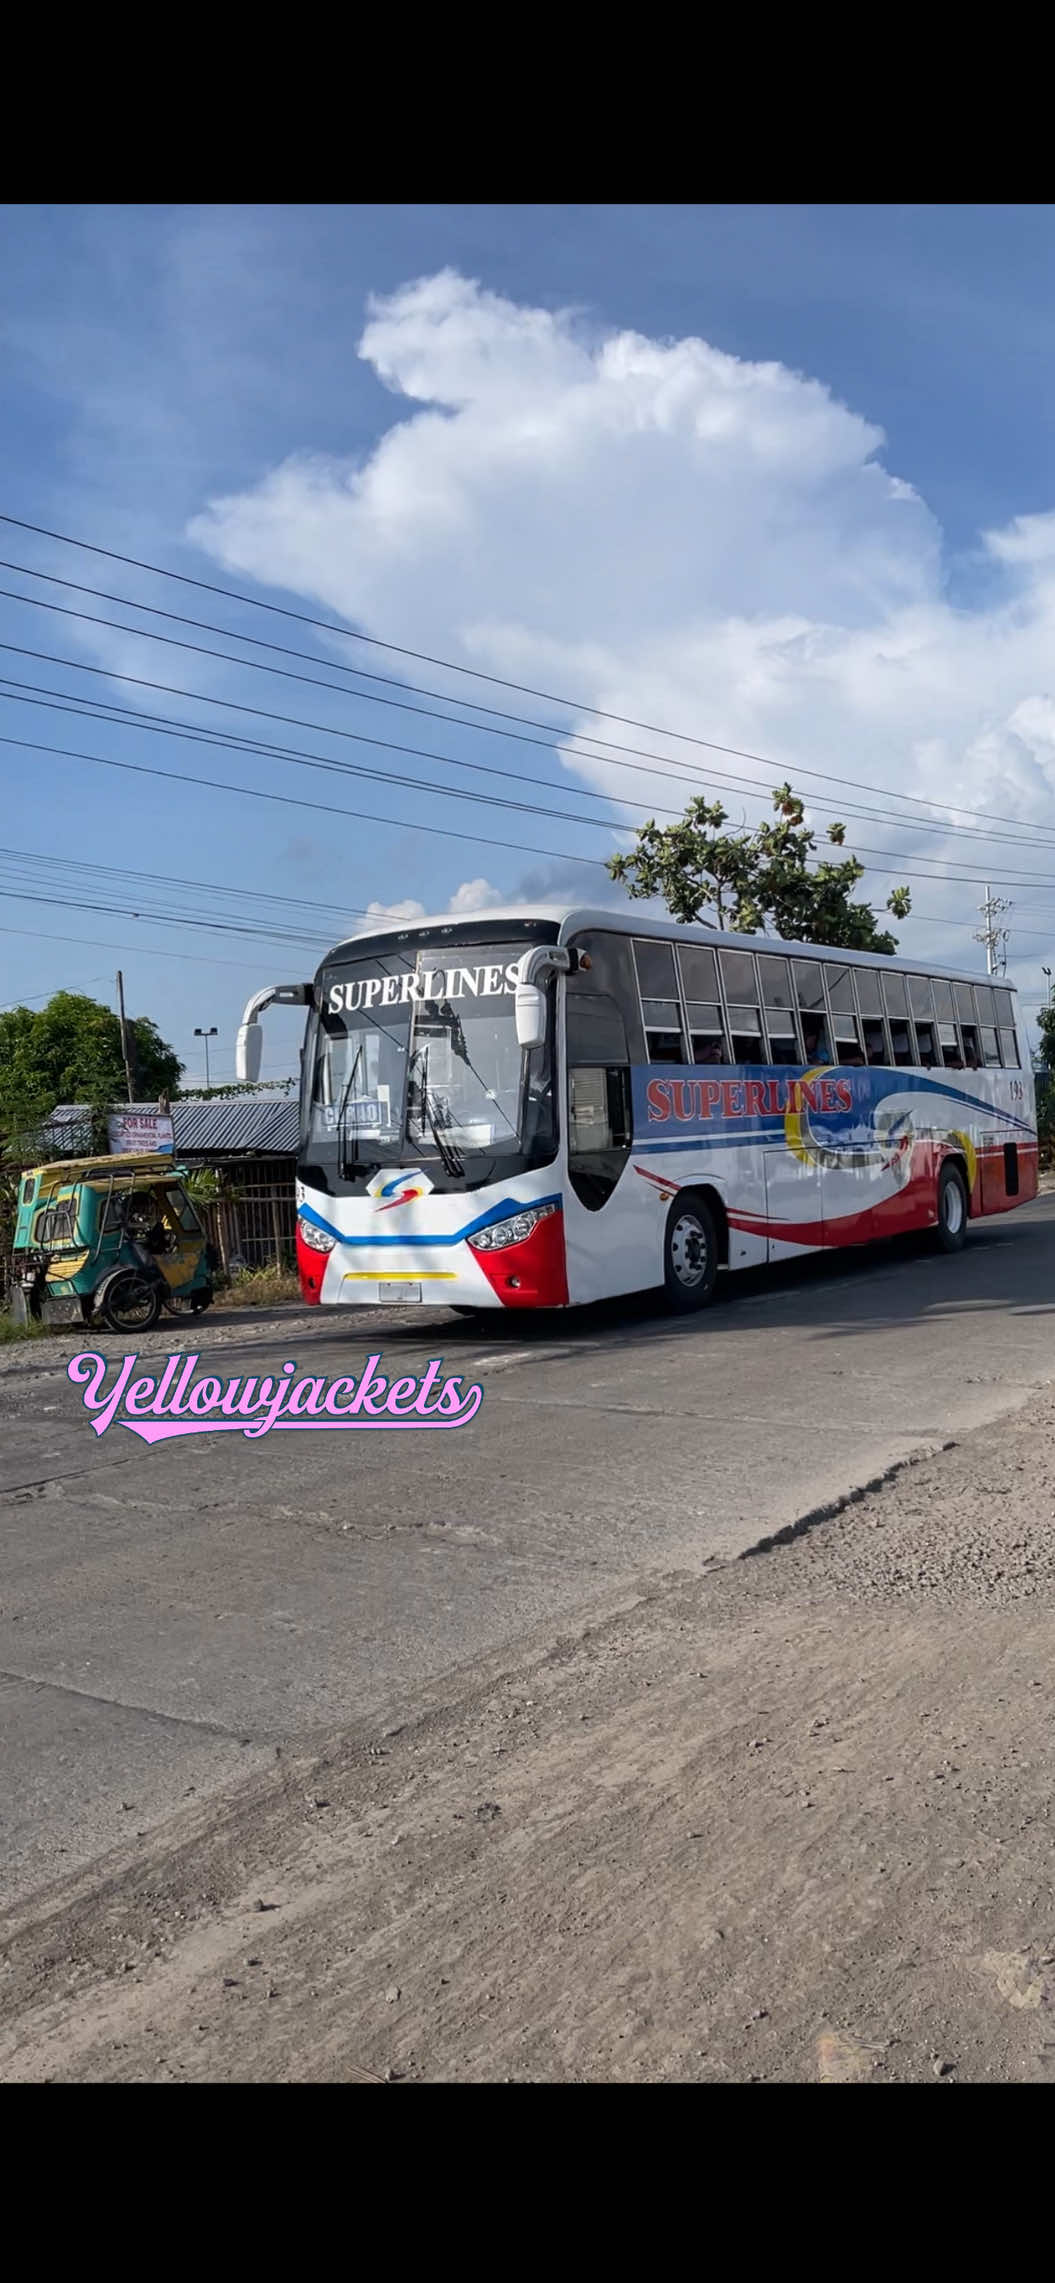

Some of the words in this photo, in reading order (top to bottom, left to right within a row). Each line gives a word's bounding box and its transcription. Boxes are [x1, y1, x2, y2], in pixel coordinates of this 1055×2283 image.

[328, 963, 520, 1015] SUPERLINES
[647, 1078, 853, 1122] SUPERLINES
[123, 1117, 138, 1129] FOR
[139, 1117, 158, 1130] SALE
